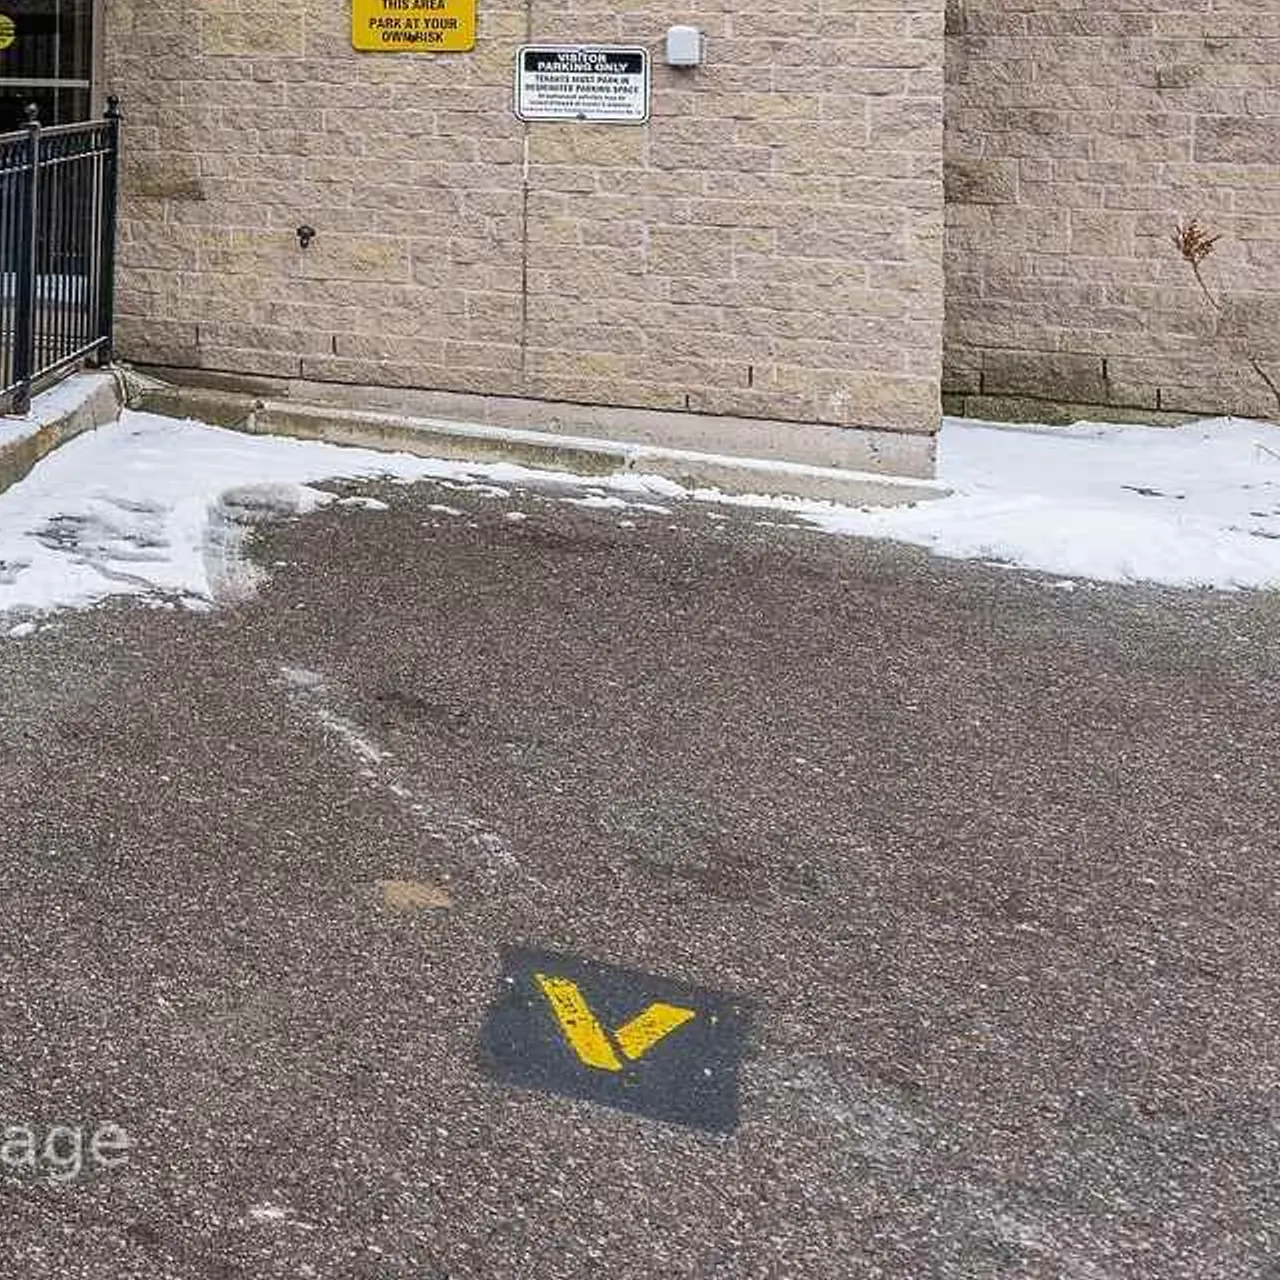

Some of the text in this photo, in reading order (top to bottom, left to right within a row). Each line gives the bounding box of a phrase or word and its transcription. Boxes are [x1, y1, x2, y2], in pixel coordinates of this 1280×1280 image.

[382, 0, 446, 11] THIS AREA
[369, 18, 458, 30] PARK AT YOUR
[382, 31, 444, 43] OWN RISK
[557, 52, 607, 63] VISITOR
[537, 61, 629, 73] PARKING ONLY
